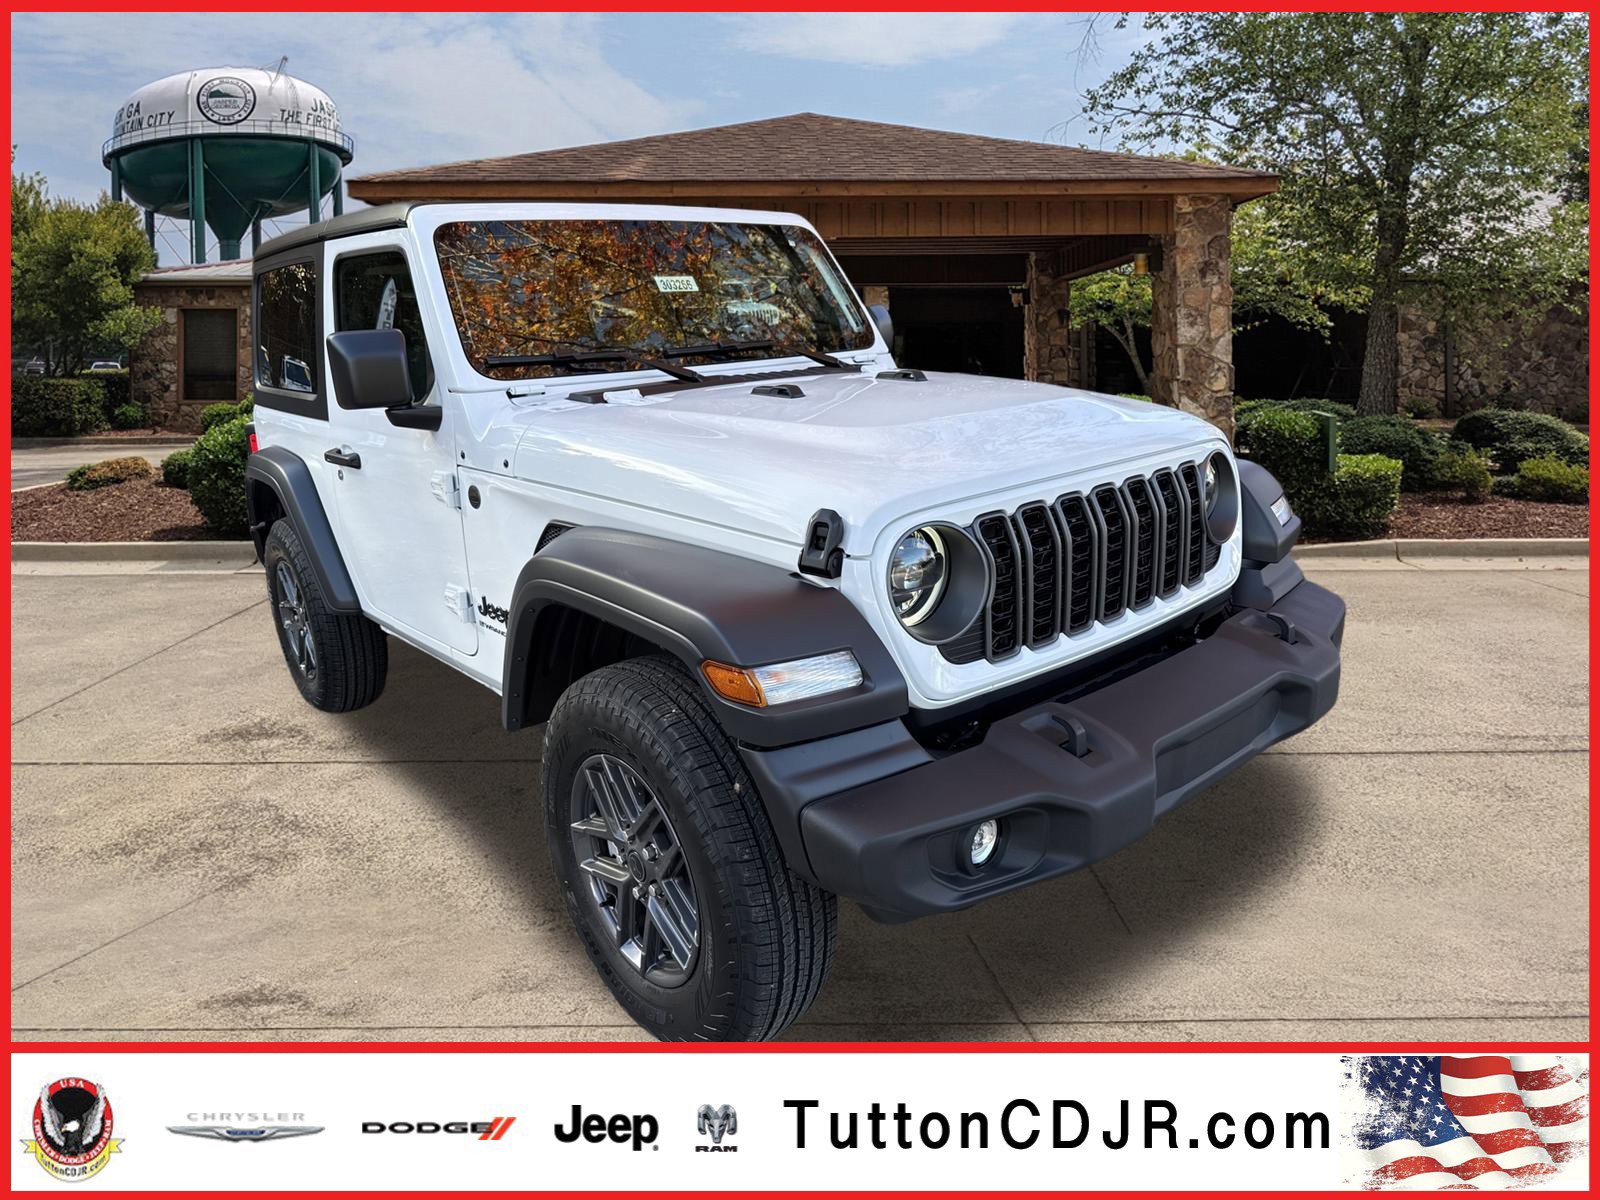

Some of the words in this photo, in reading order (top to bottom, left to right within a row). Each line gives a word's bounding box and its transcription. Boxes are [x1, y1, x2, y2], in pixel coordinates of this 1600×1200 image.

[127, 100, 141, 119] GA
[280, 109, 302, 124] THE
[147, 110, 176, 127] CITY
